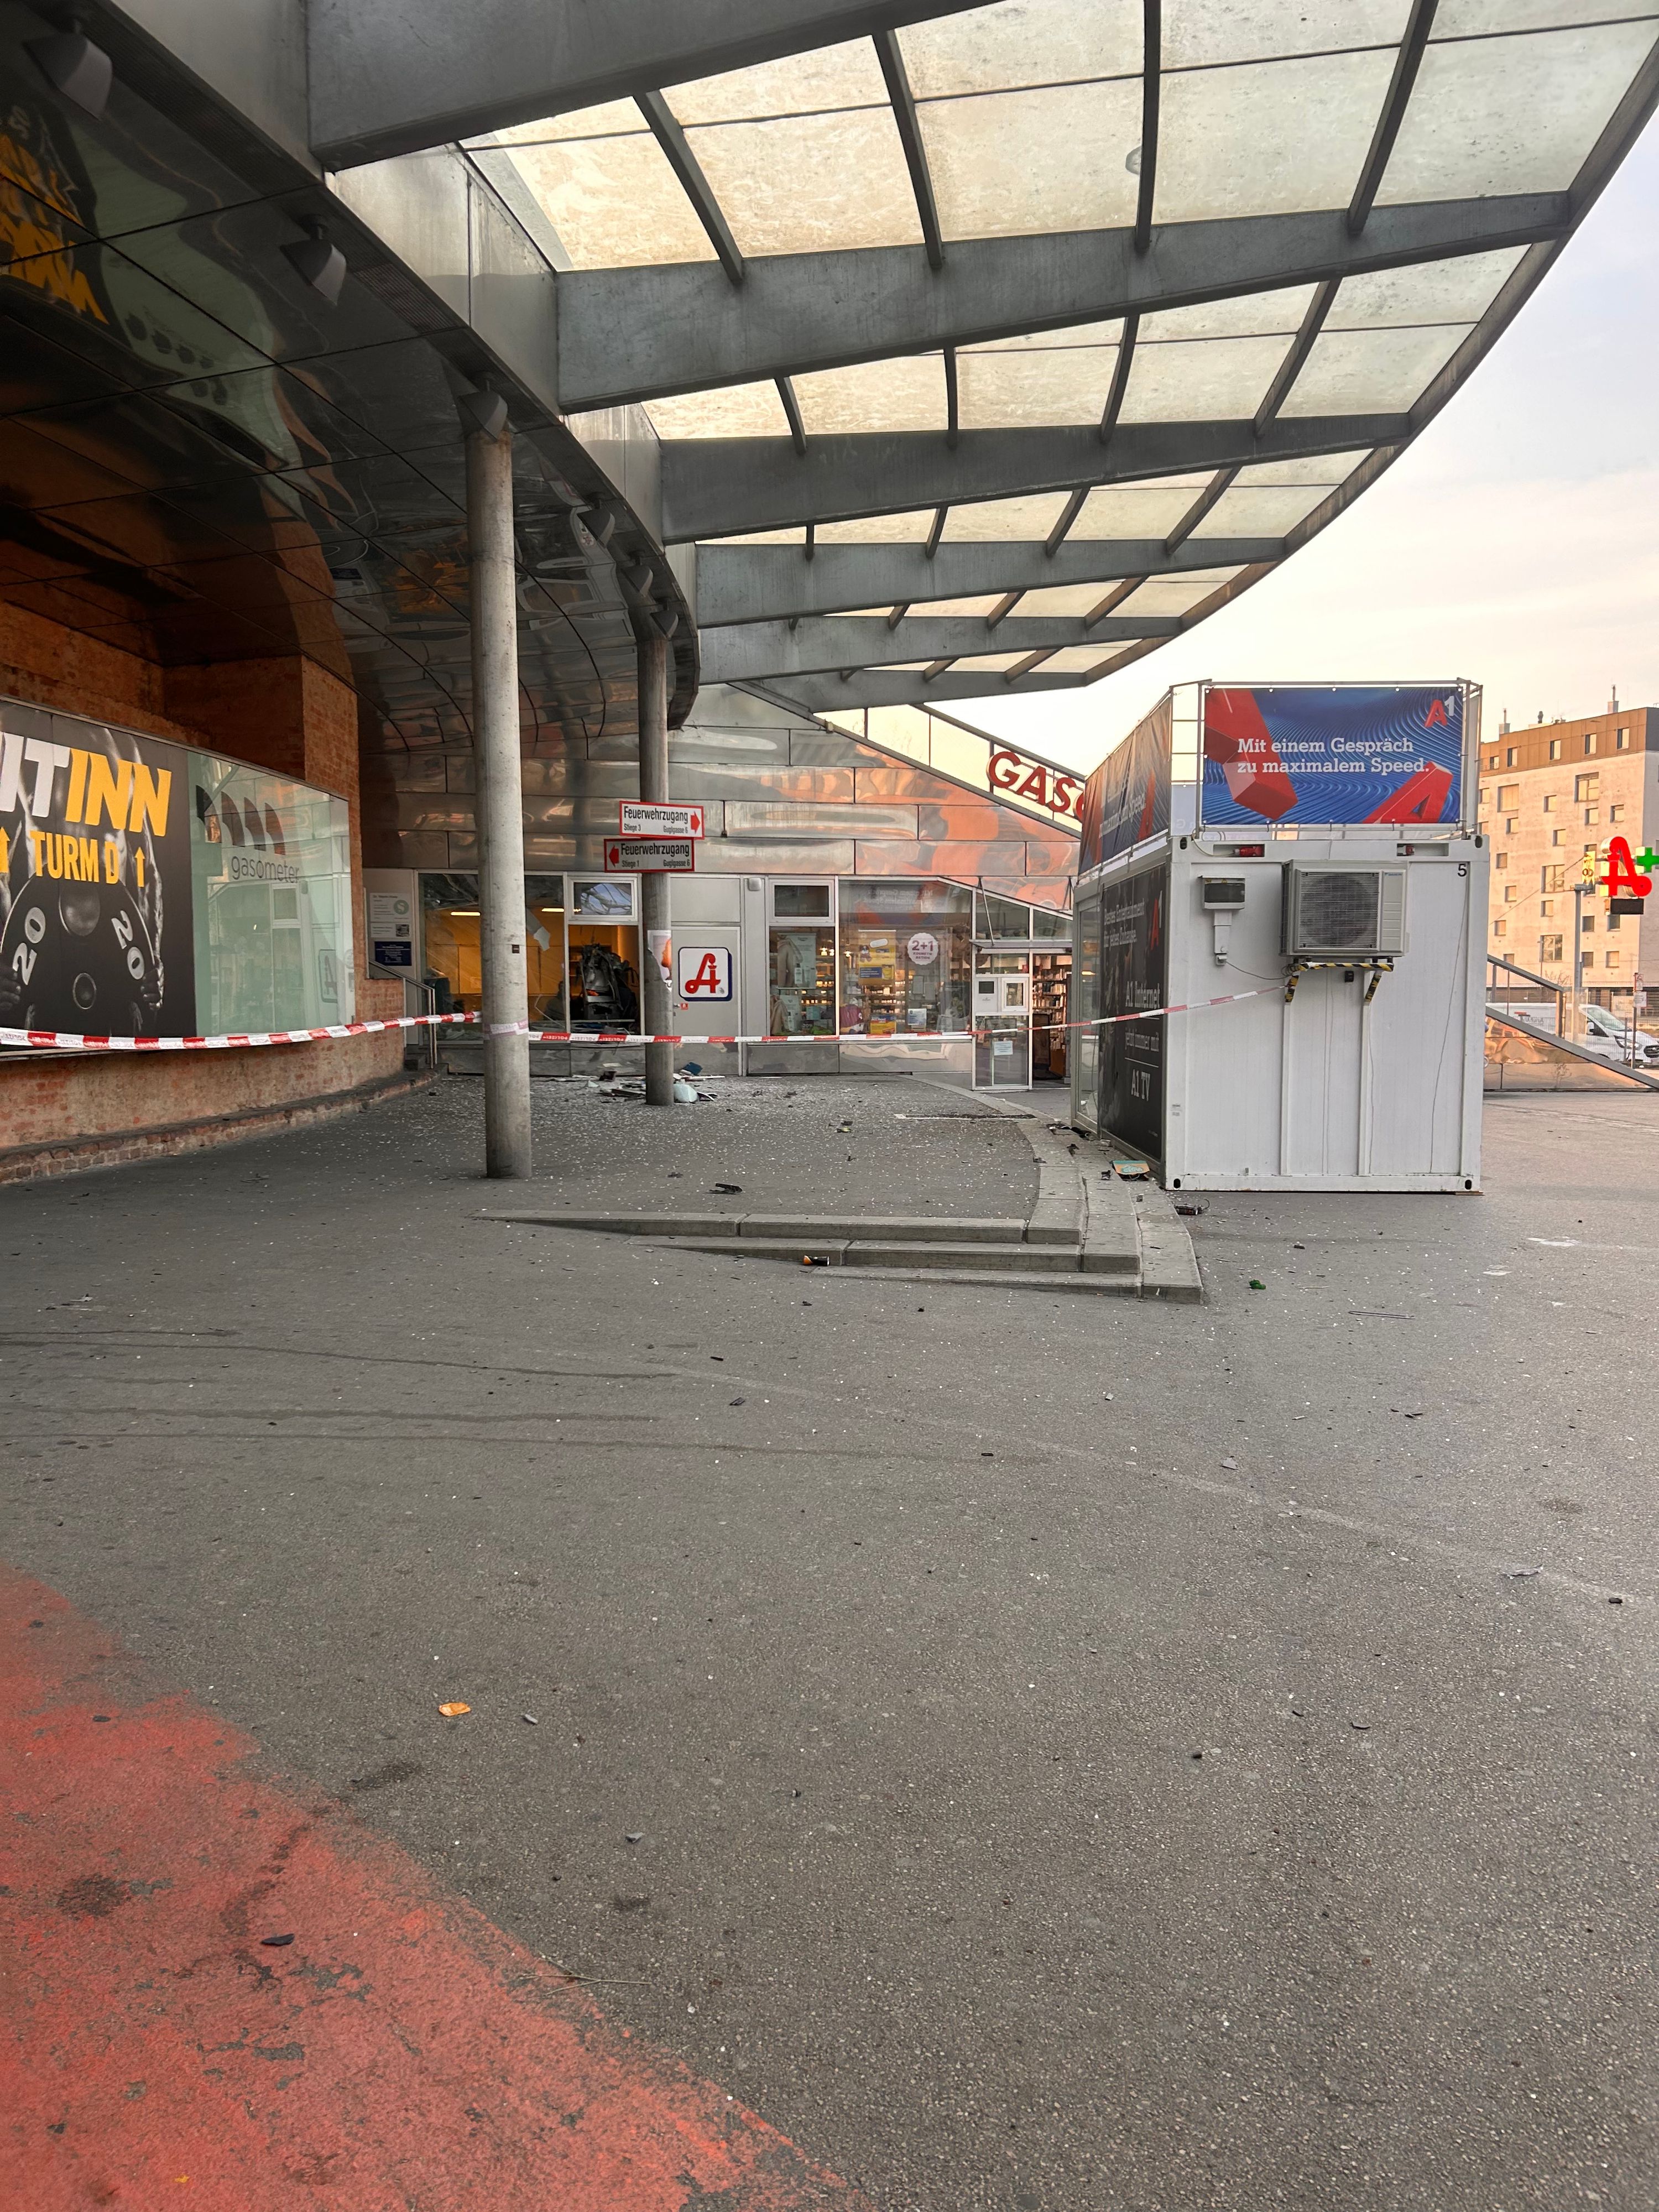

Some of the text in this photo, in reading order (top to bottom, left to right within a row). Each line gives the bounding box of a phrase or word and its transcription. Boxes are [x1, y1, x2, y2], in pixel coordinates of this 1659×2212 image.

[1425, 696, 1454, 728] A1
[1238, 738, 1413, 756] Mit einem Gespräch
[1238, 758, 1430, 776] zu maximalem Speed.
[986, 751, 1084, 822] GAS
[624, 806, 688, 825] Feuerwehrzugang
[624, 823, 637, 833] Stiege
[30, 831, 119, 884] TURM D
[621, 843, 690, 857] Feuerwehrzugang
[231, 856, 300, 884] gasometer
[622, 860, 636, 868] Stiege
[1458, 863, 1467, 877] 5
[912, 940, 933, 951] 2+1
[1125, 980, 1160, 1009] A1 Internet
[1131, 1069, 1151, 1101] A1 TV
